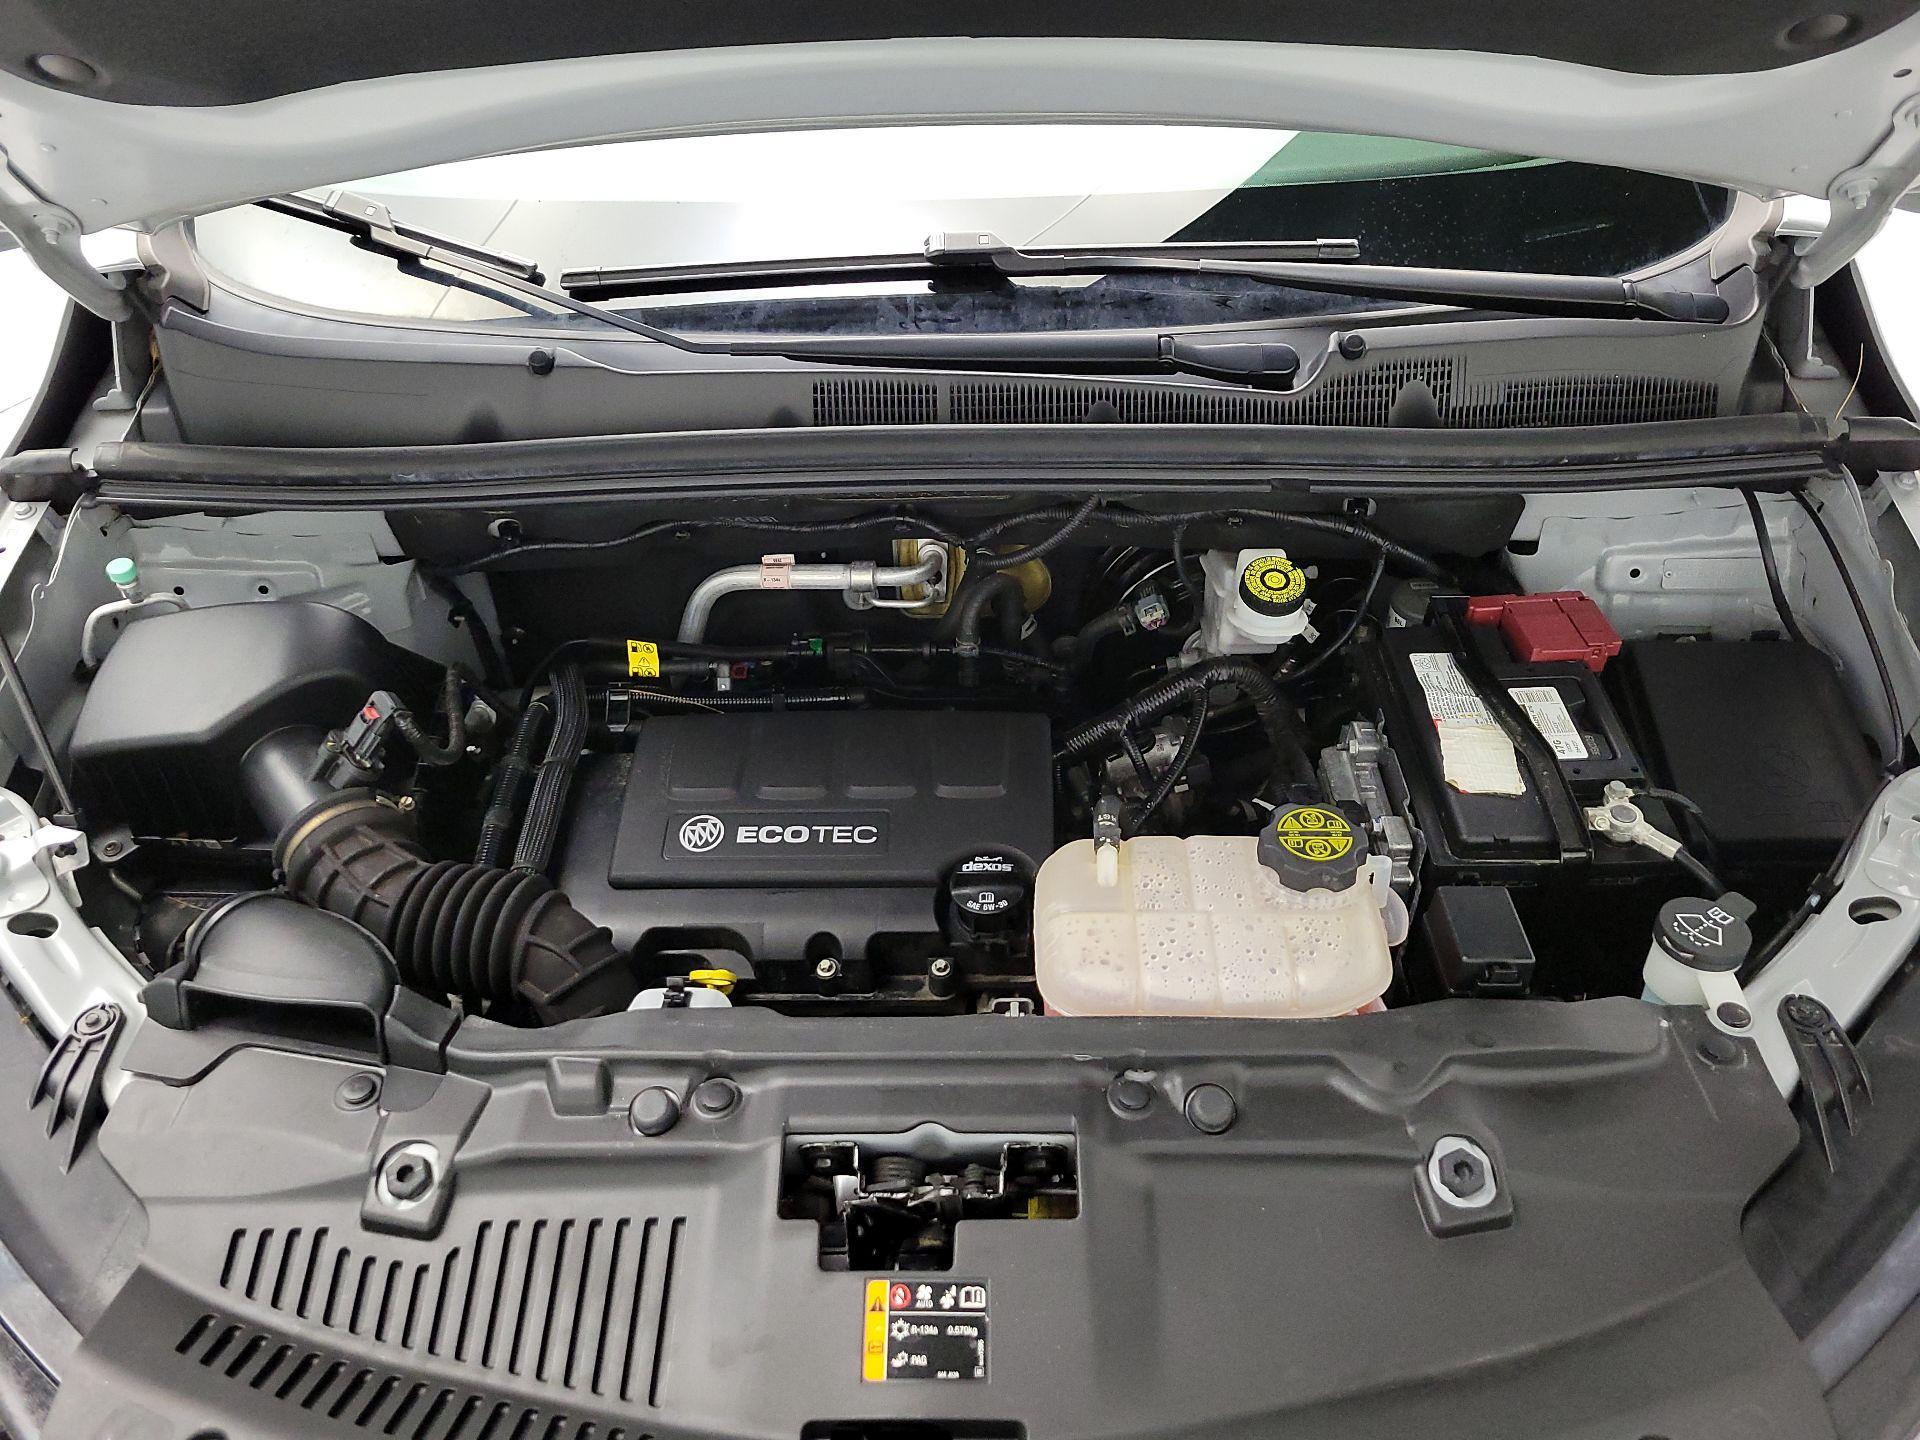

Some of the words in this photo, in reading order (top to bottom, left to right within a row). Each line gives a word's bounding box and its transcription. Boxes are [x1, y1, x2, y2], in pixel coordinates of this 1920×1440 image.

[736, 825, 878, 844] ECOTEC
[961, 861, 1012, 872] dexos
[966, 900, 981, 911] SAE
[911, 1354, 928, 1366] PAG
